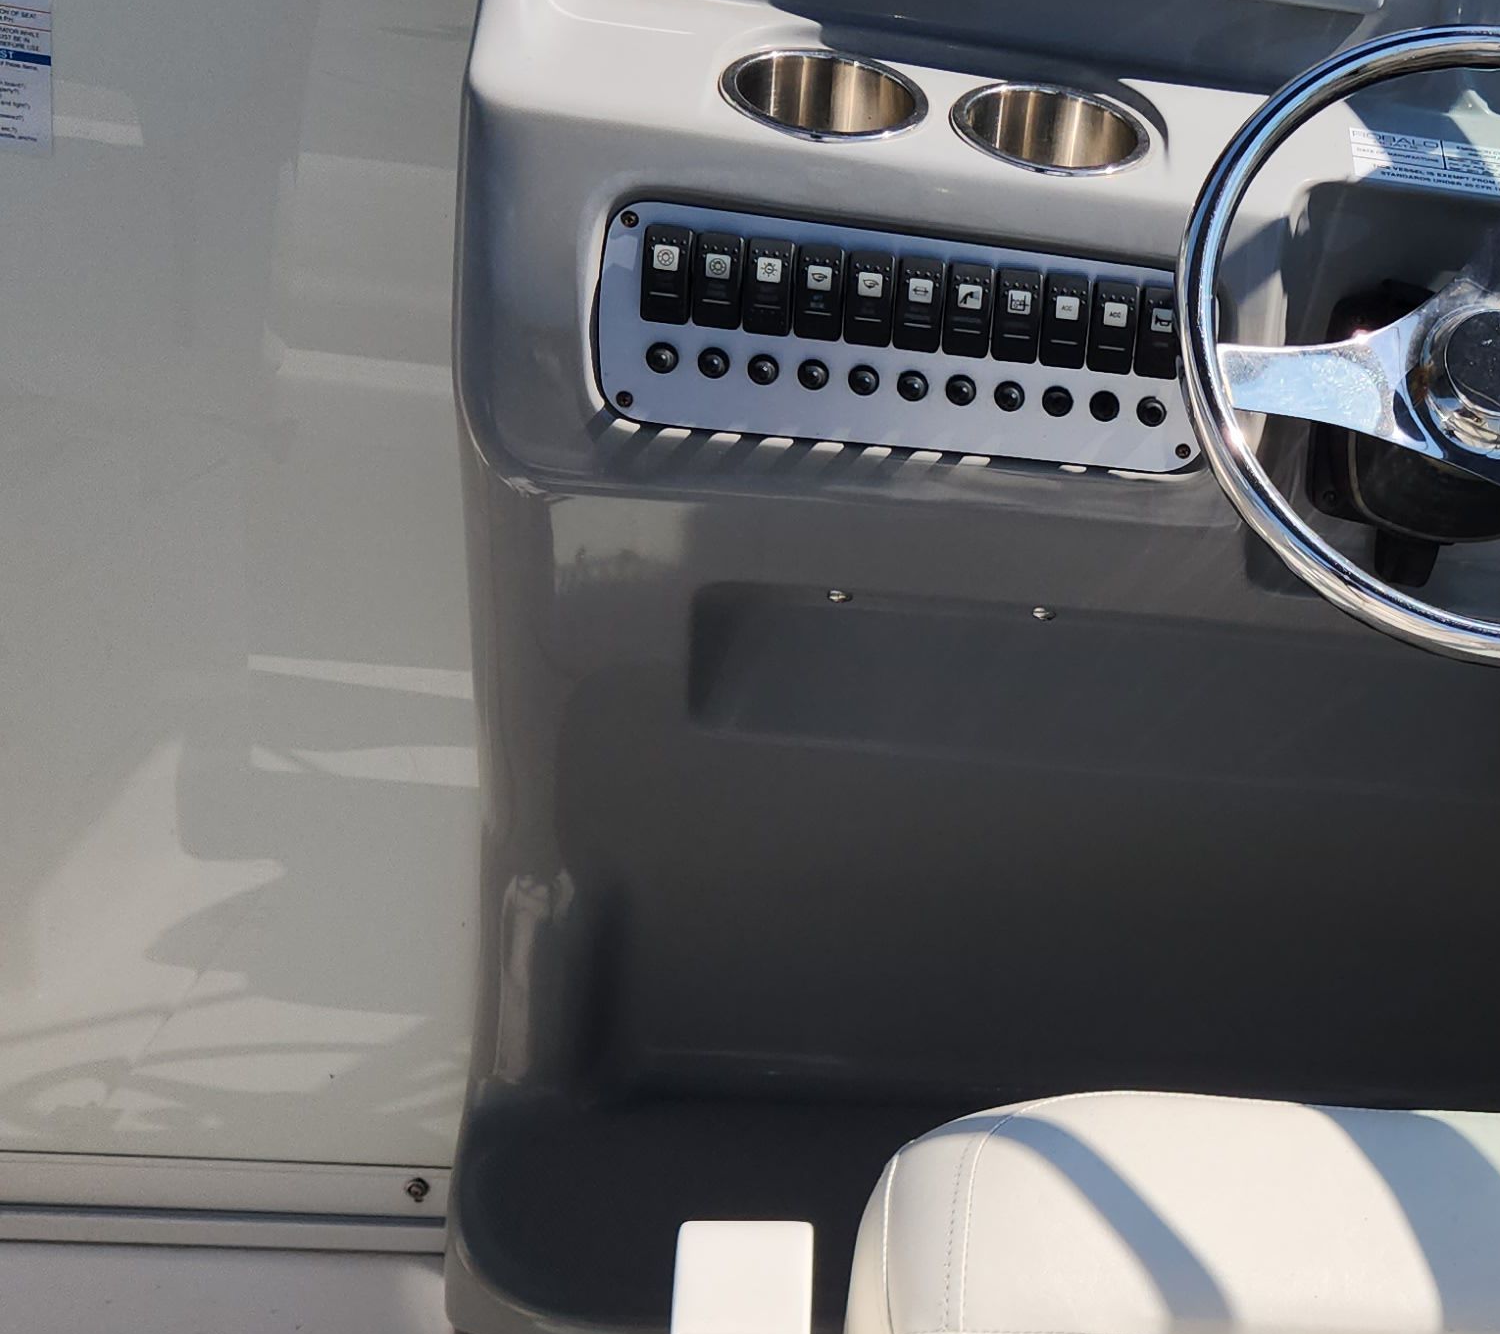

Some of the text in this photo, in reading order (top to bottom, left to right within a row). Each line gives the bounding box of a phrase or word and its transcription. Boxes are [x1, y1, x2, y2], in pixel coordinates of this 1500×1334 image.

[1380, 170, 1432, 183] STANDARDS
[1432, 177, 1463, 187] UNDER
[1393, 165, 1425, 175] VESSEL
[1436, 172, 1470, 182] EXEMPT
[1471, 175, 1496, 185] FROM
